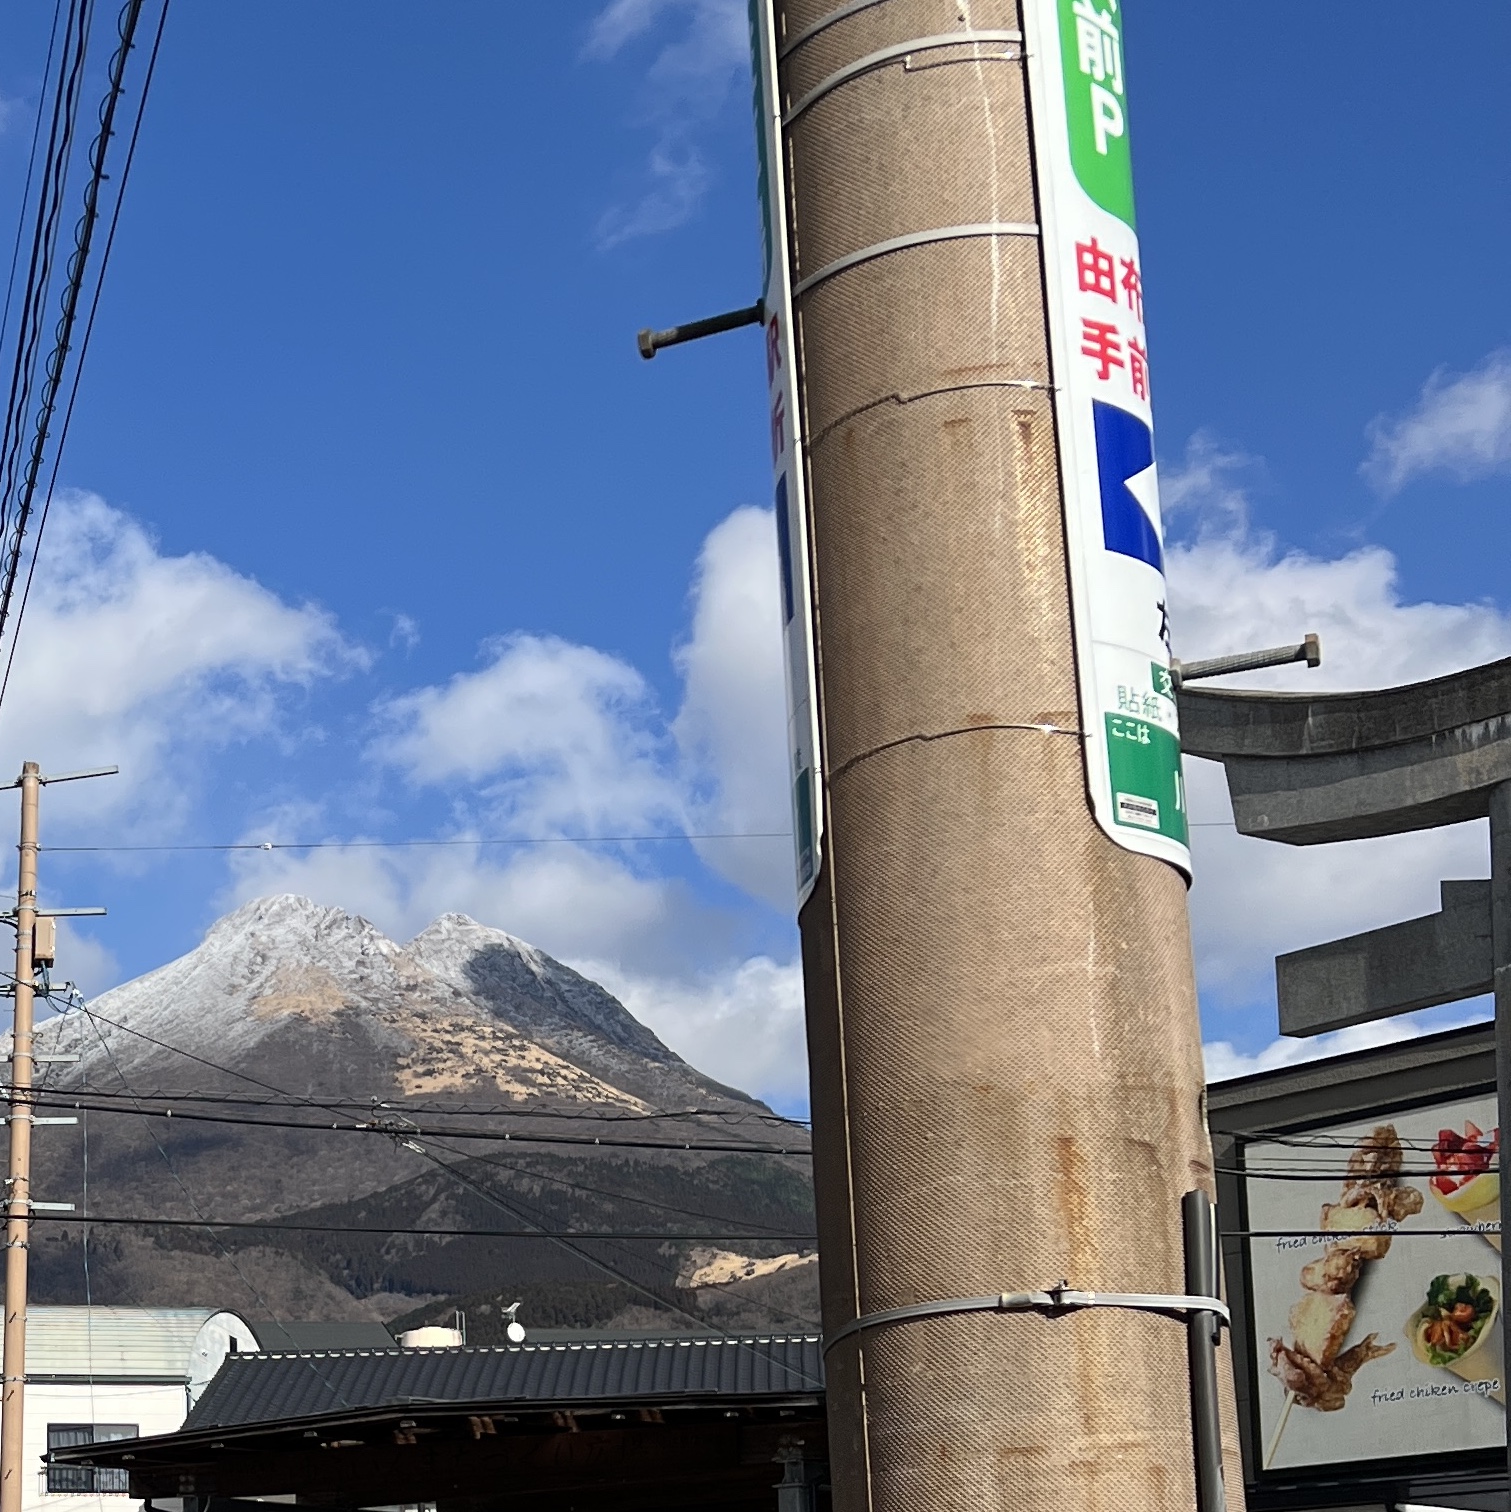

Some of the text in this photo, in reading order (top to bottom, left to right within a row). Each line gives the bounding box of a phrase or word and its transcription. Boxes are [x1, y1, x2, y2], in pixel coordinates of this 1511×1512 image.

[1111, 718, 1151, 745] ここは
[1371, 1380, 1499, 1407] fried chiken crepe
